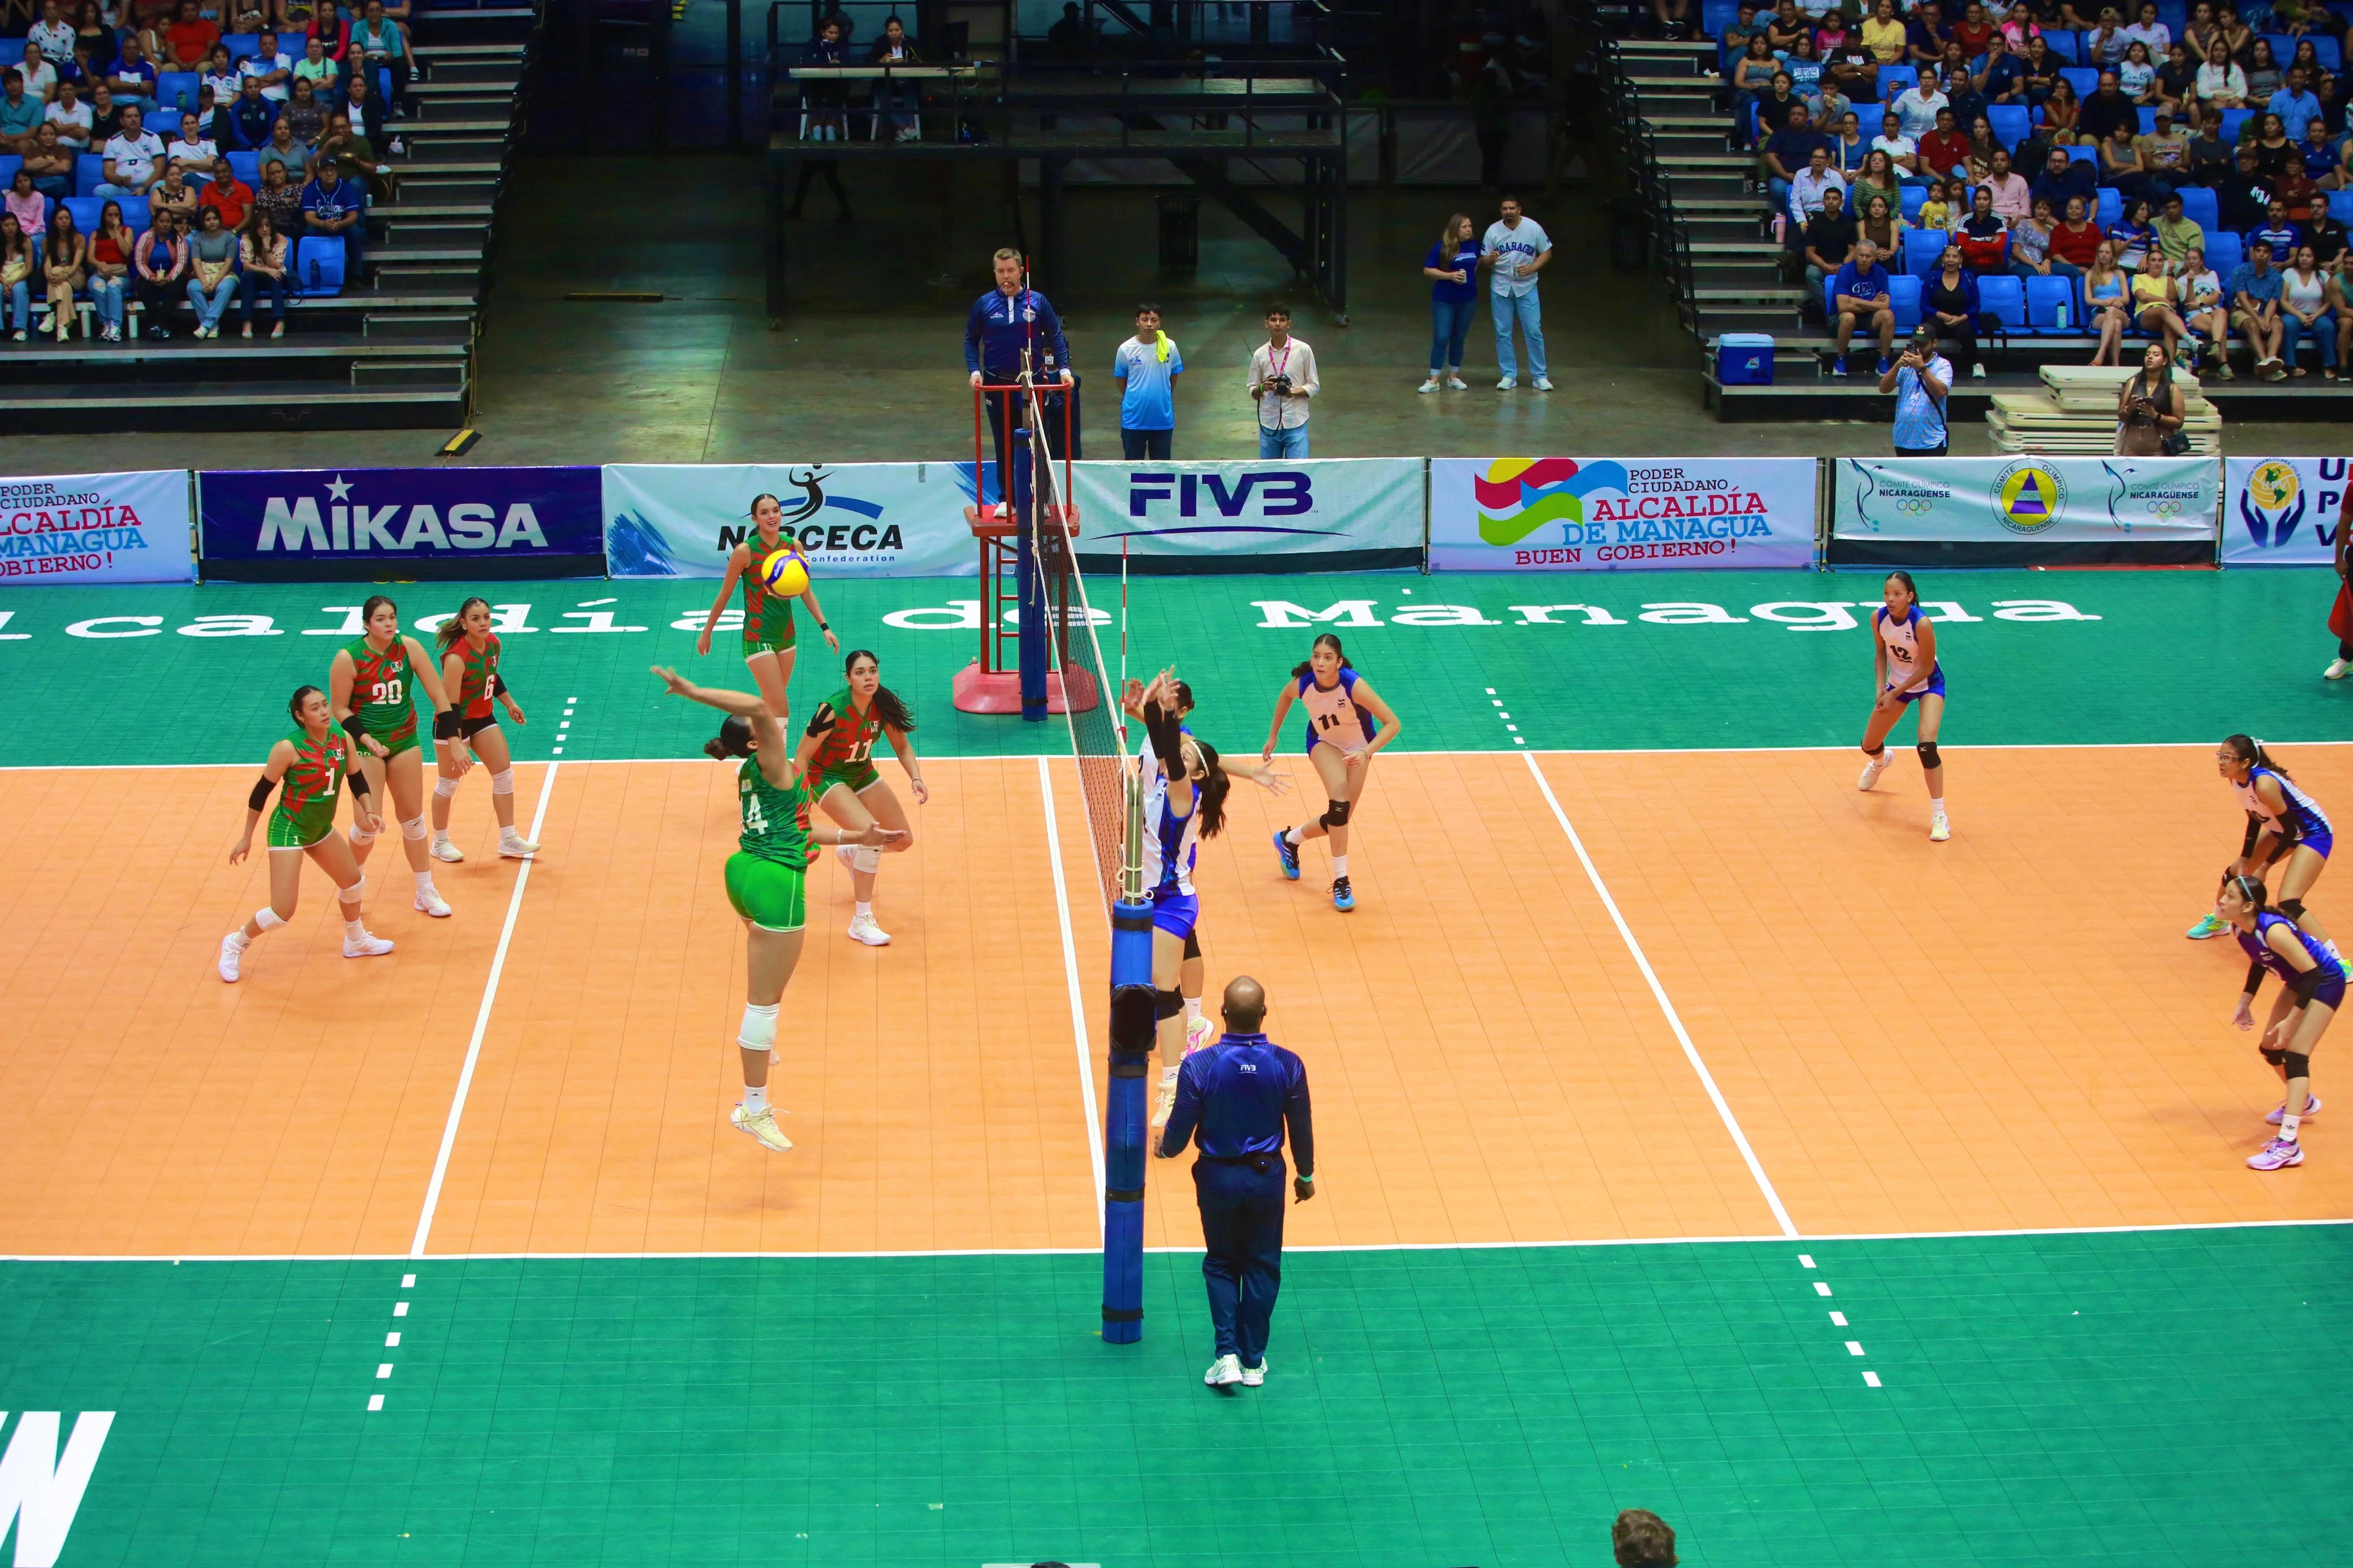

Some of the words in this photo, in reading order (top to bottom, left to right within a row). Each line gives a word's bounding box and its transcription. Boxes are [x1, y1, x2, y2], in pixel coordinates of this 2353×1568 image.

[1630, 468, 1685, 481] PODER
[1994, 465, 2016, 494] COMITE
[2042, 465, 2065, 499] OLIMPICO
[1, 483, 56, 497] PODER
[1628, 480, 1728, 494] CIUDADANO
[1912, 480, 1950, 489] OLÍMPICO
[2131, 482, 2159, 491] COMITÉ
[2161, 481, 2200, 490] OLÍMPICO
[1, 493, 100, 510] CIUDADANO
[1130, 472, 1313, 517] FIVB
[1879, 489, 1951, 498] NICARAGÜENSE
[2130, 490, 2199, 499] NICARAGÜENSE
[1592, 486, 1768, 521] ALCALDÍA
[2317, 491, 2340, 514] P
[1562, 522, 1606, 546] DE
[1617, 515, 1773, 543] MANAGUA
[2002, 516, 2055, 533] NICARAGUENSE
[1515, 548, 1582, 565] BUEN
[1249, 601, 2102, 631] Managua
[1889, 645, 1912, 660] 12
[372, 679, 402, 705] 20
[484, 675, 494, 701] 6
[1318, 714, 1340, 731] 11
[845, 739, 872, 763] 11
[323, 767, 335, 796] 1
